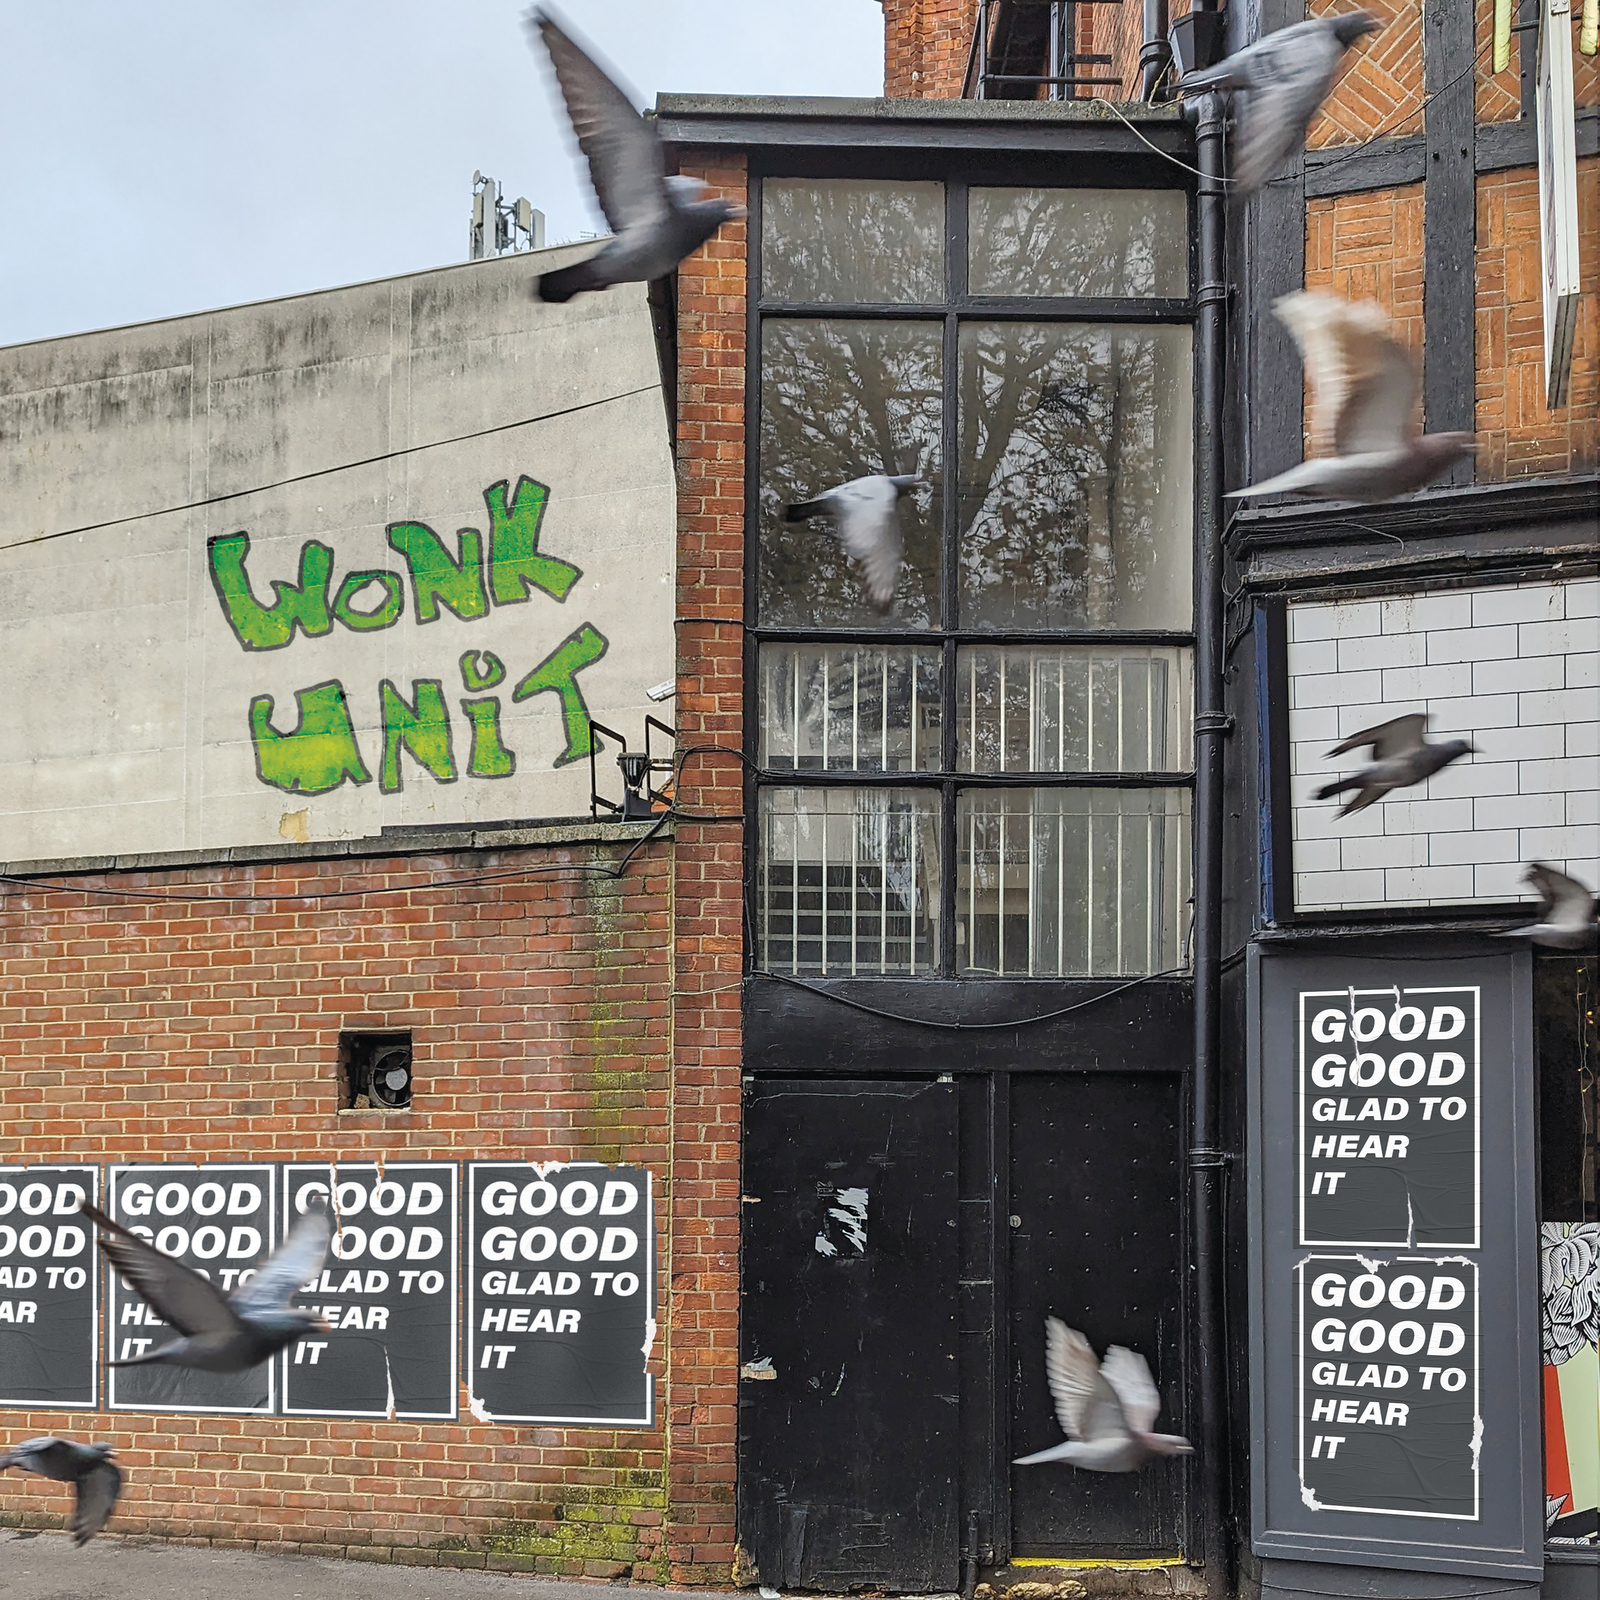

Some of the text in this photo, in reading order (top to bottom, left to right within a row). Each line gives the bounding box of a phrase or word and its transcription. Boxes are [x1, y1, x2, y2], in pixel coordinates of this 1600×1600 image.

[207, 474, 584, 652] WONK
[1311, 1006, 1466, 1043] GOOD
[1311, 1052, 1466, 1088] GOOD
[1311, 1096, 1467, 1122] GLAD TO
[1311, 1134, 1410, 1158] HEAR
[1311, 1171, 1346, 1195] IT
[121, 1182, 262, 1216] GOOD
[295, 1181, 444, 1216] GOOD
[481, 1180, 639, 1216] GOOD
[331, 1225, 444, 1261] OOD
[481, 1226, 639, 1262] GOOD
[45, 1266, 87, 1290] TO
[398, 1270, 445, 1295] TO
[481, 1270, 640, 1297] GLAD TO
[1311, 1273, 1466, 1311] GOOD
[120, 1302, 171, 1326] HE
[298, 1305, 390, 1330] EAR
[481, 1308, 581, 1333] HEAR
[120, 1337, 153, 1360] IT
[1311, 1317, 1466, 1357] GOOD
[294, 1341, 329, 1365] IT
[480, 1345, 517, 1369] IT
[1311, 1361, 1467, 1392] GLAD TO
[1311, 1398, 1410, 1427] HEAR
[1311, 1435, 1346, 1459] IT
